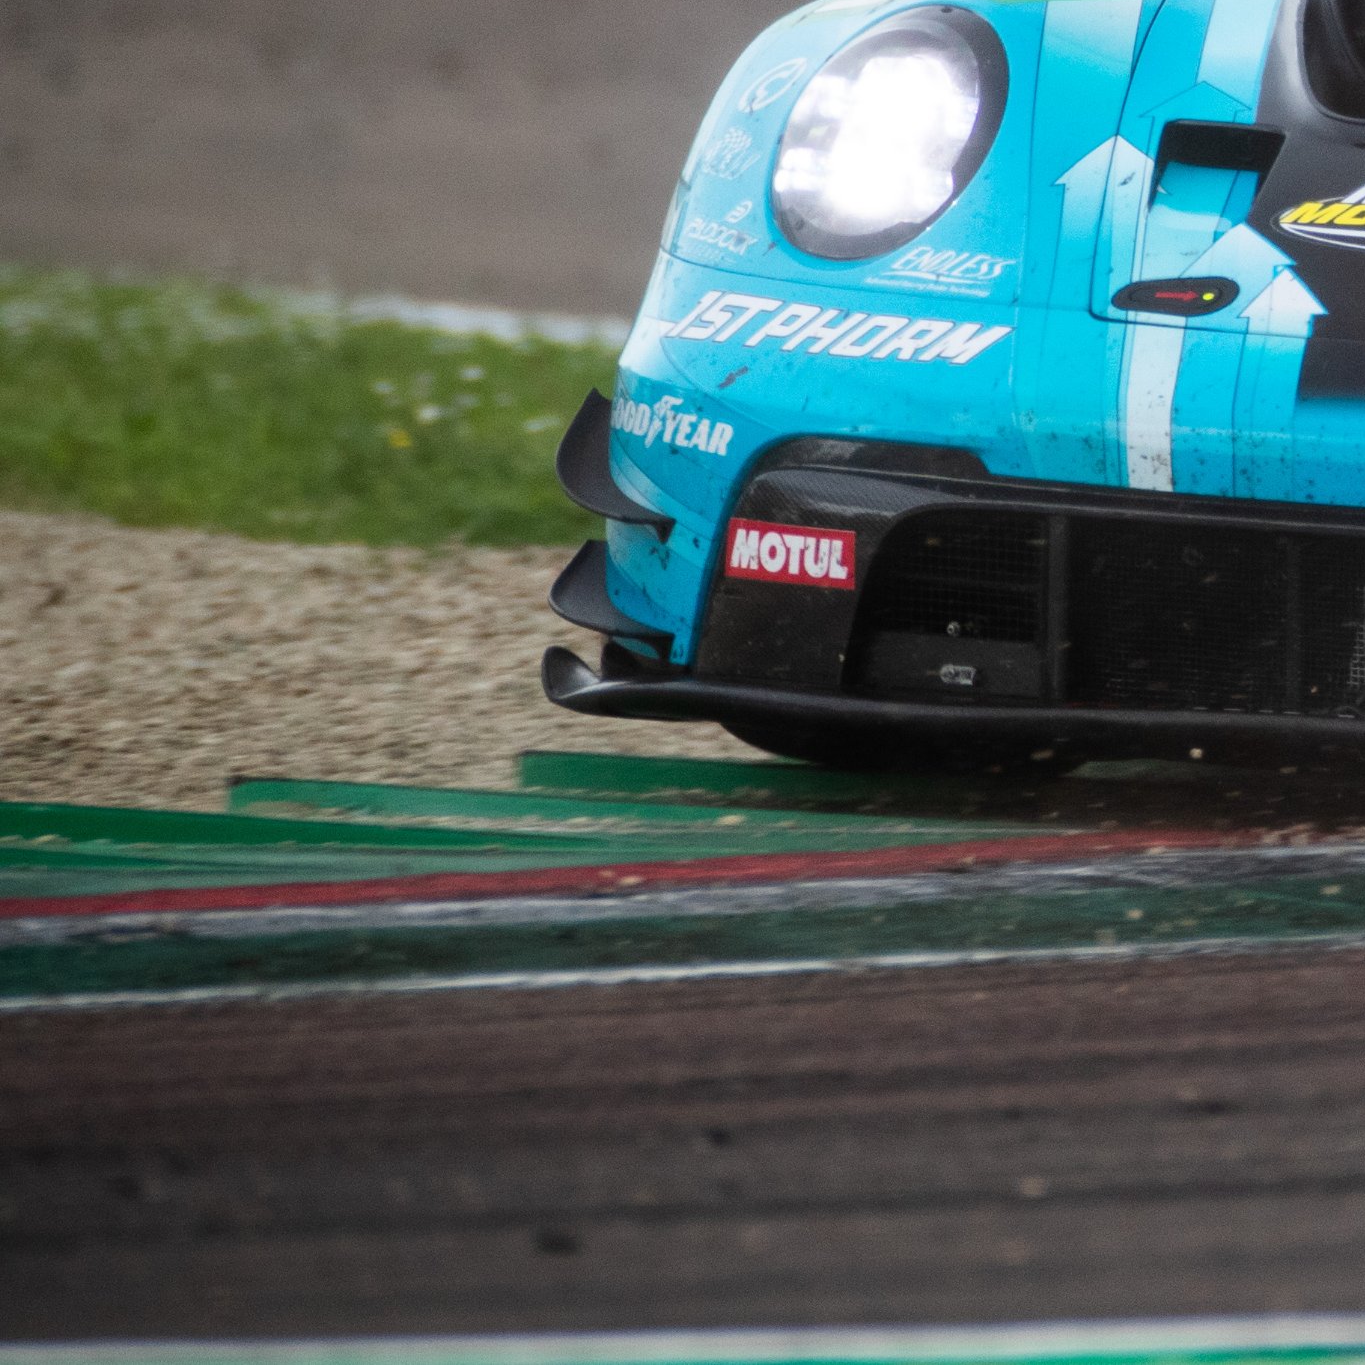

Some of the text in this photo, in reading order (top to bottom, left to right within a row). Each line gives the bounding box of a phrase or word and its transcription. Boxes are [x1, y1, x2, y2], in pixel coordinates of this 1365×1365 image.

[891, 245, 1017, 280] ENDLESS
[662, 290, 1013, 365] 1ST PHORM
[730, 526, 850, 582] MOTUL
